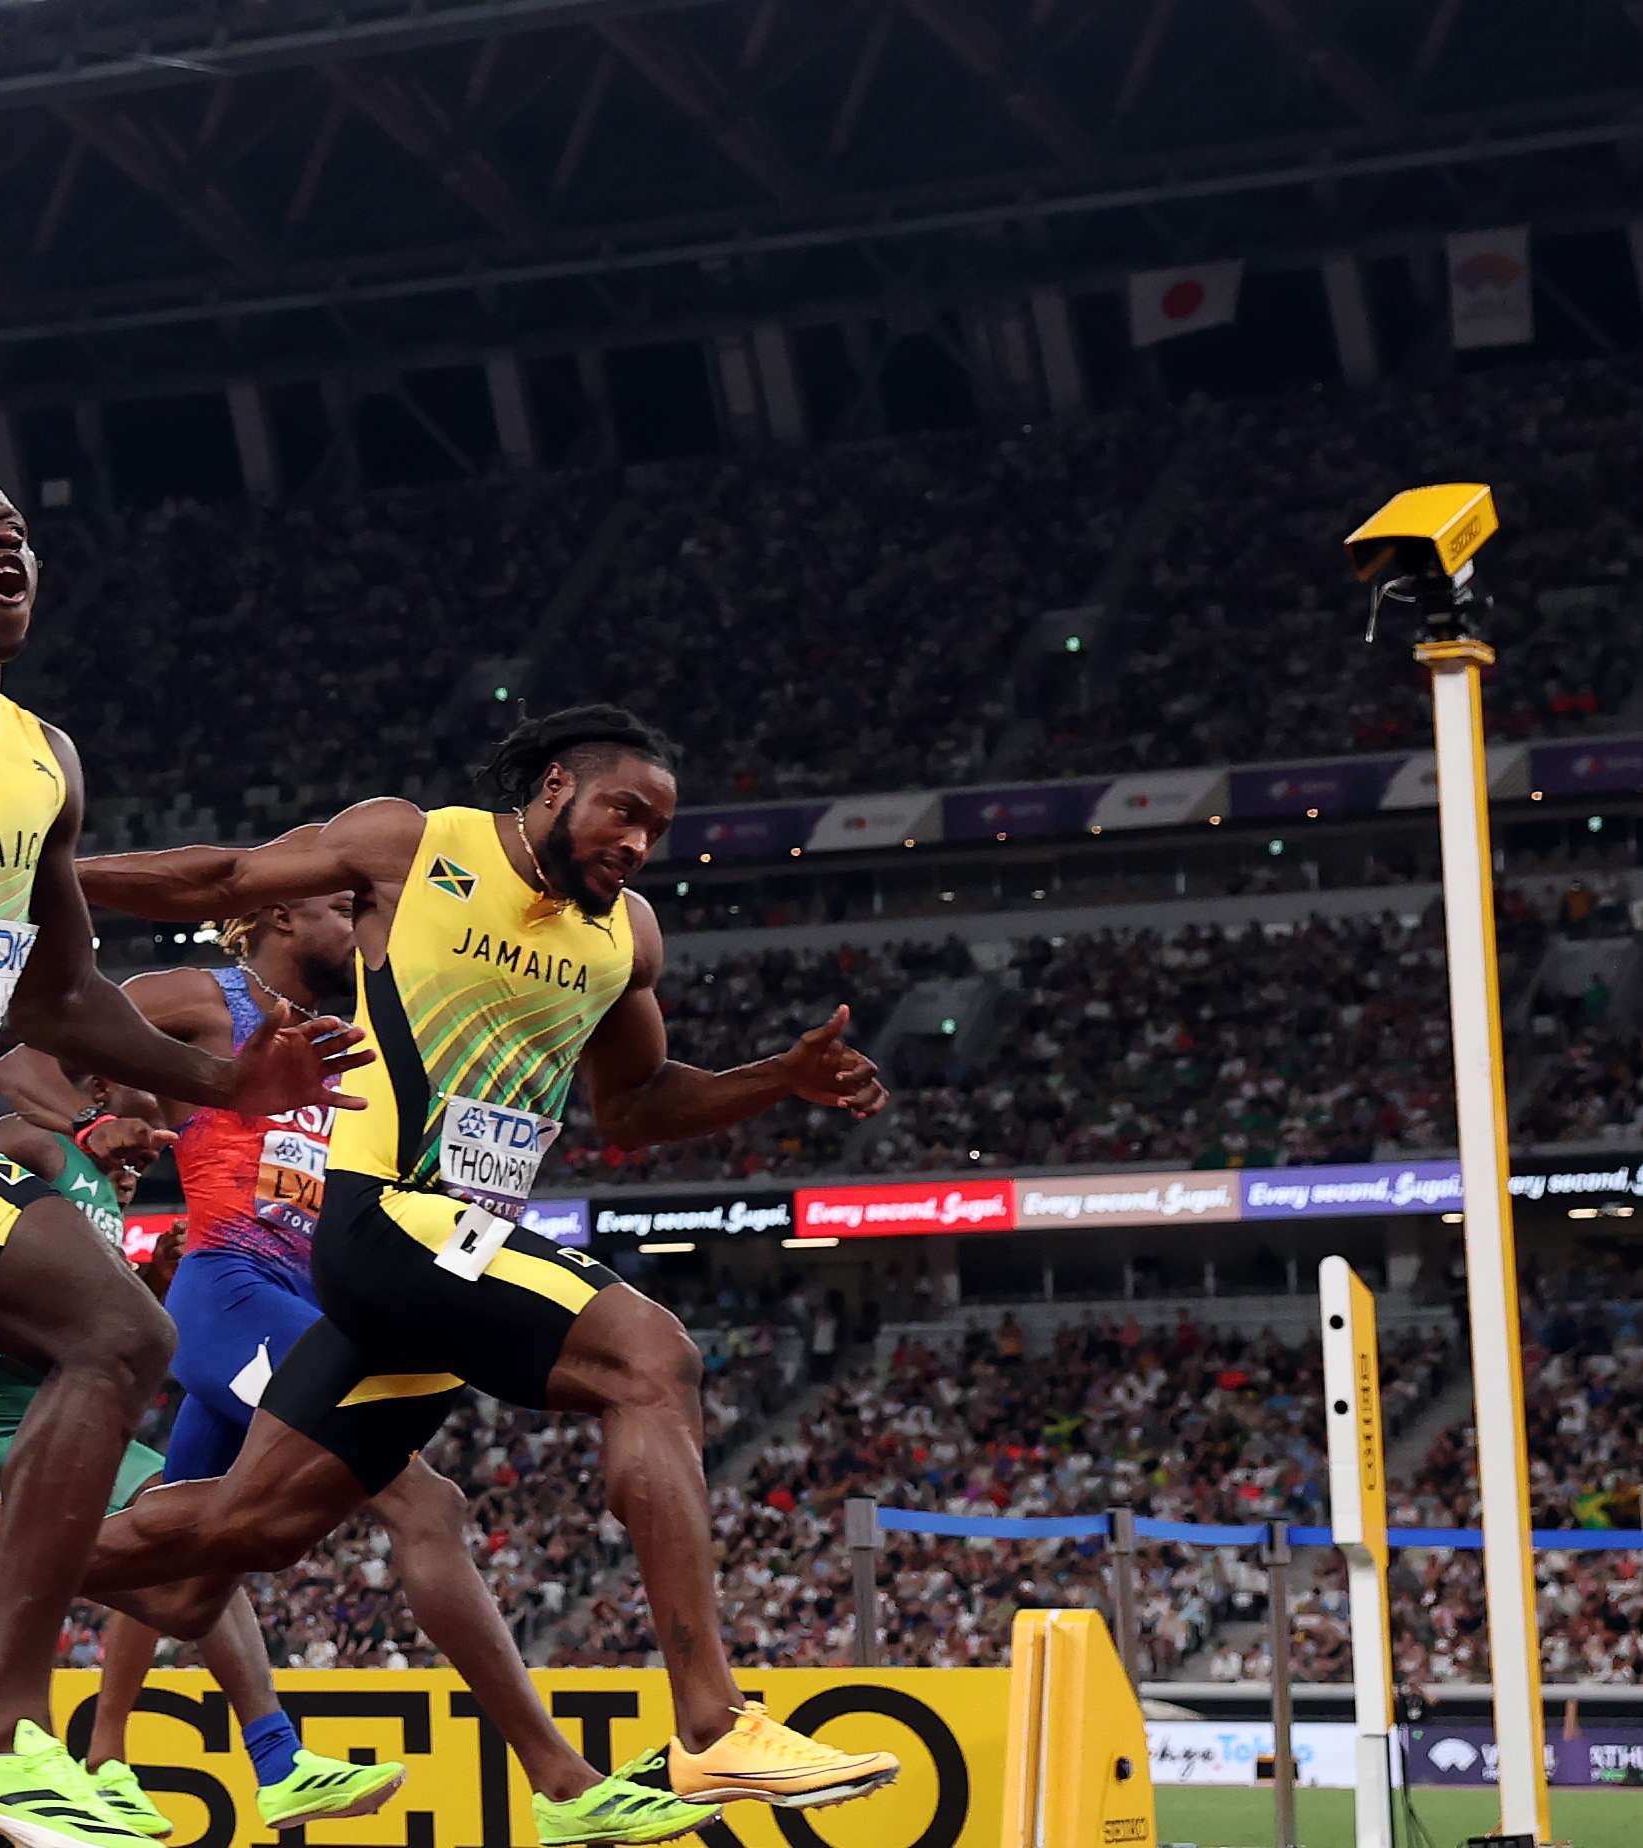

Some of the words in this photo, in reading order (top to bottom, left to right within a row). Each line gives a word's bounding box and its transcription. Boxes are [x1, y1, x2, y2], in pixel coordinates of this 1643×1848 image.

[452, 927, 587, 993] JAMAICA
[488, 1111, 553, 1152] TDK
[447, 1144, 536, 1191] THOMPS
[274, 1170, 319, 1212] LYL
[282, 1210, 314, 1234] TOK
[596, 1210, 652, 1236] Every
[806, 1201, 864, 1227] Every
[1218, 1733, 1314, 1766] Toko
